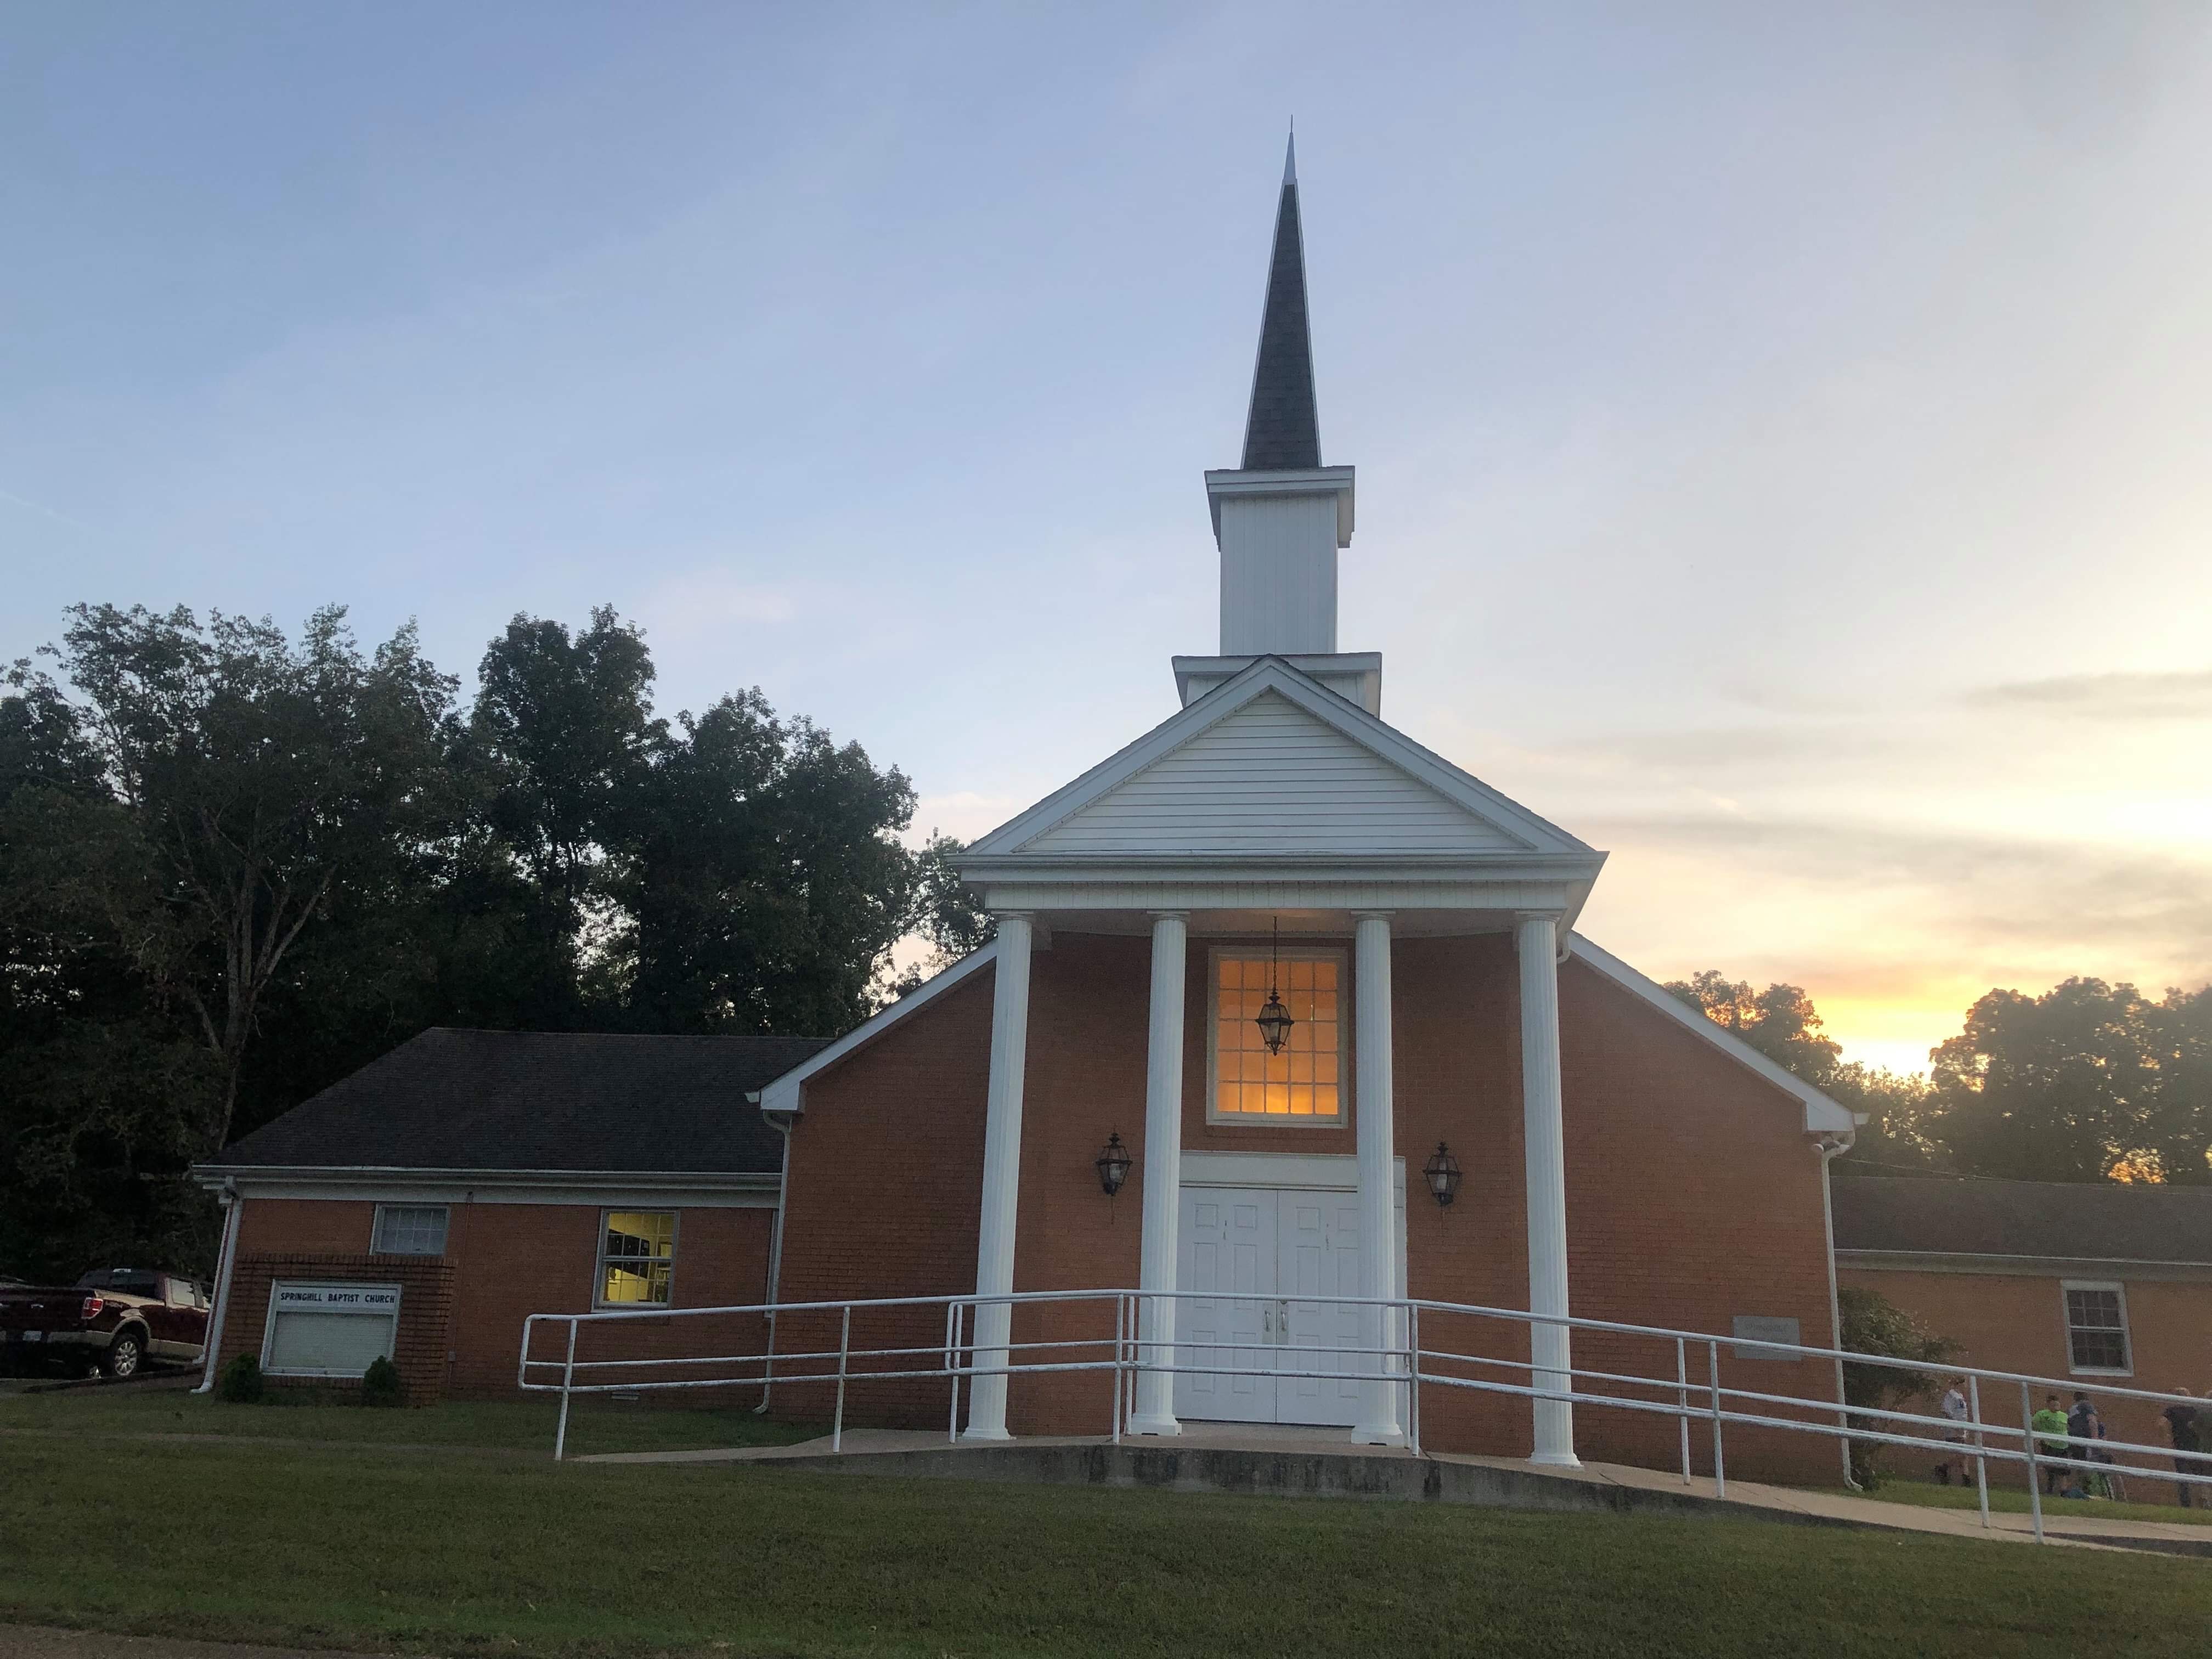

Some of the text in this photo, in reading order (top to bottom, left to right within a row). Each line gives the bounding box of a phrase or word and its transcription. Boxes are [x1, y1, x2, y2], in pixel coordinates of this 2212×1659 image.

[280, 1292, 396, 1304] SPRINGHILL BAPTIST CHURCH
